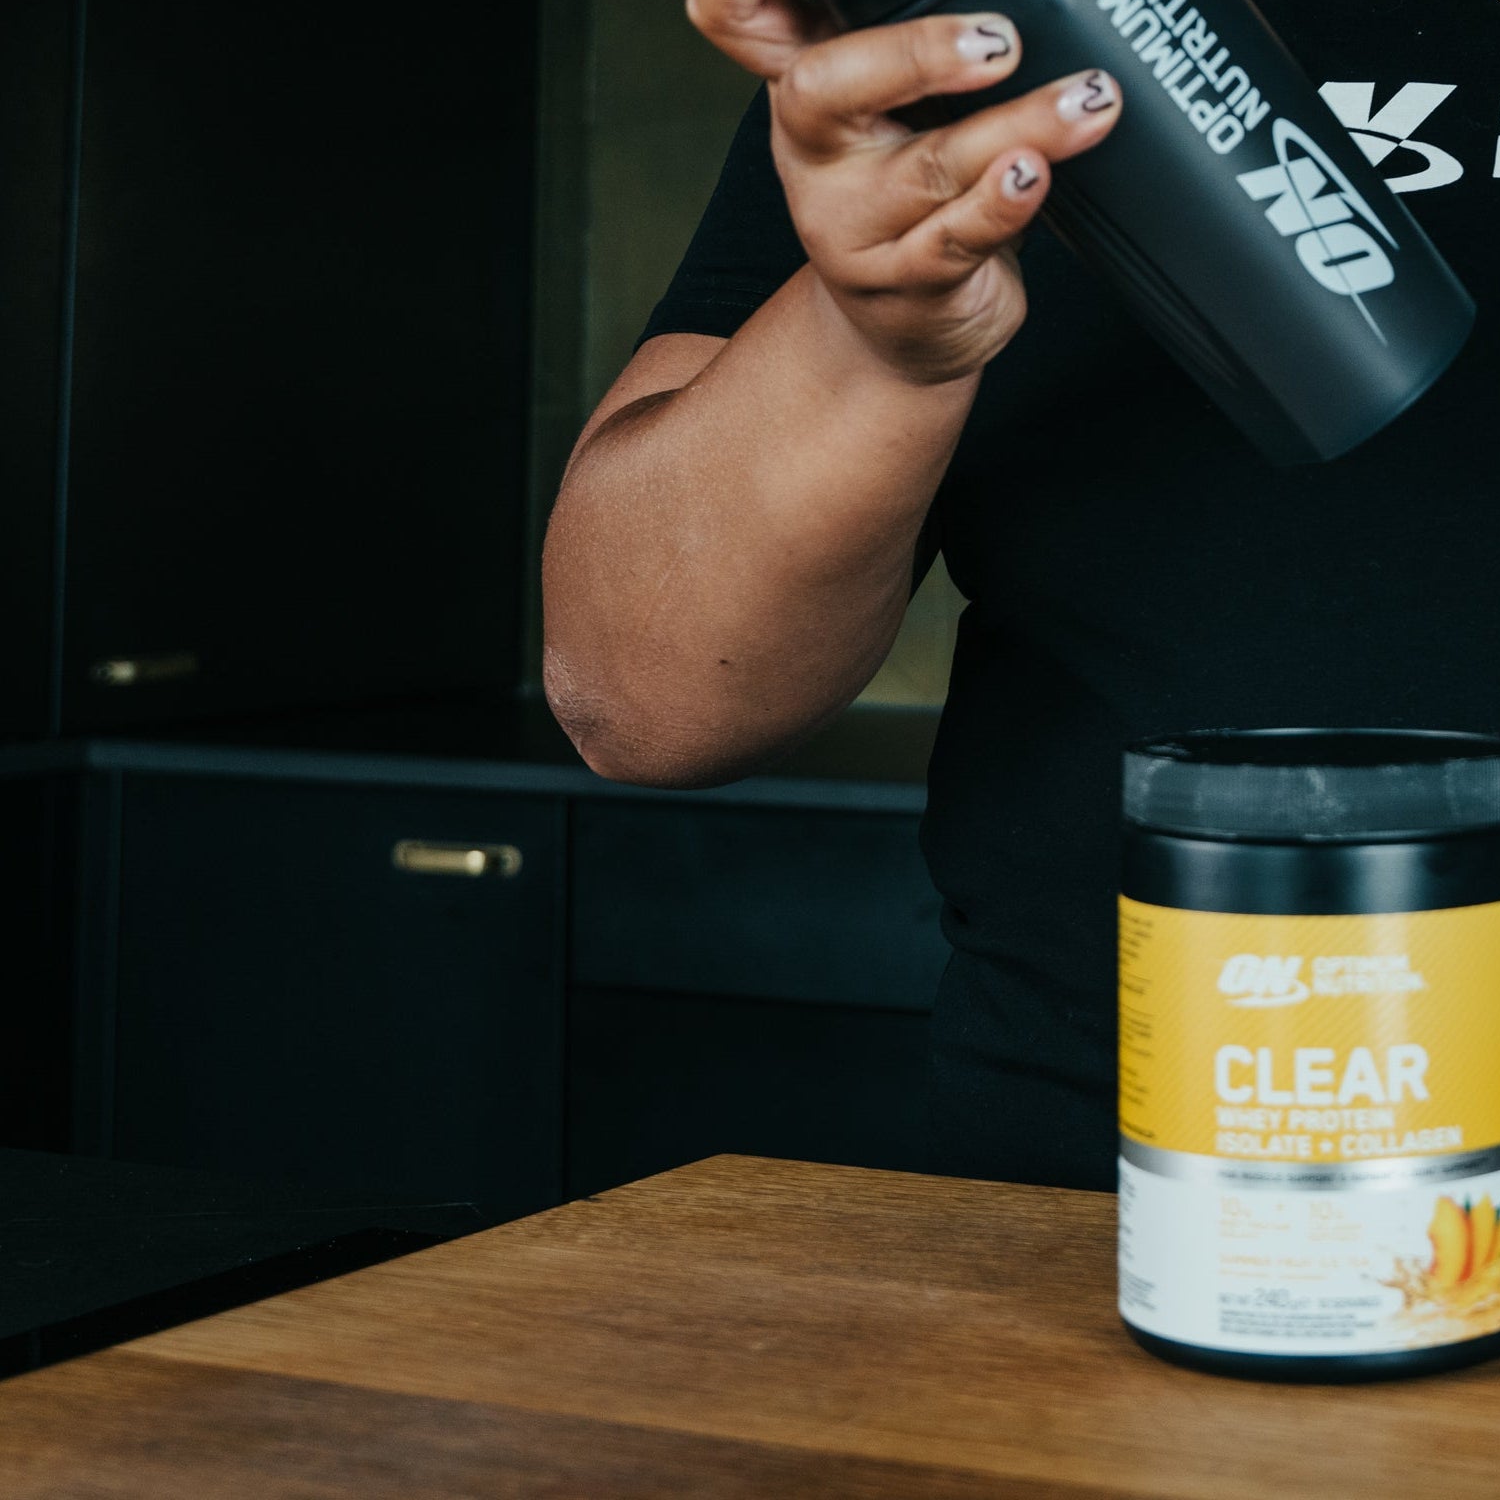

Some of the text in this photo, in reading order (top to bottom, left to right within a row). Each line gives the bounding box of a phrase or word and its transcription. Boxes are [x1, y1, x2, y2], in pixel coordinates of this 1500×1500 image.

[1214, 1043, 1430, 1105] CLEAR
[1214, 1106, 1396, 1132] WHEY PROTEIN
[1214, 1130, 1313, 1157] ISOLATE
[1339, 1125, 1463, 1158] COLLAGEN
